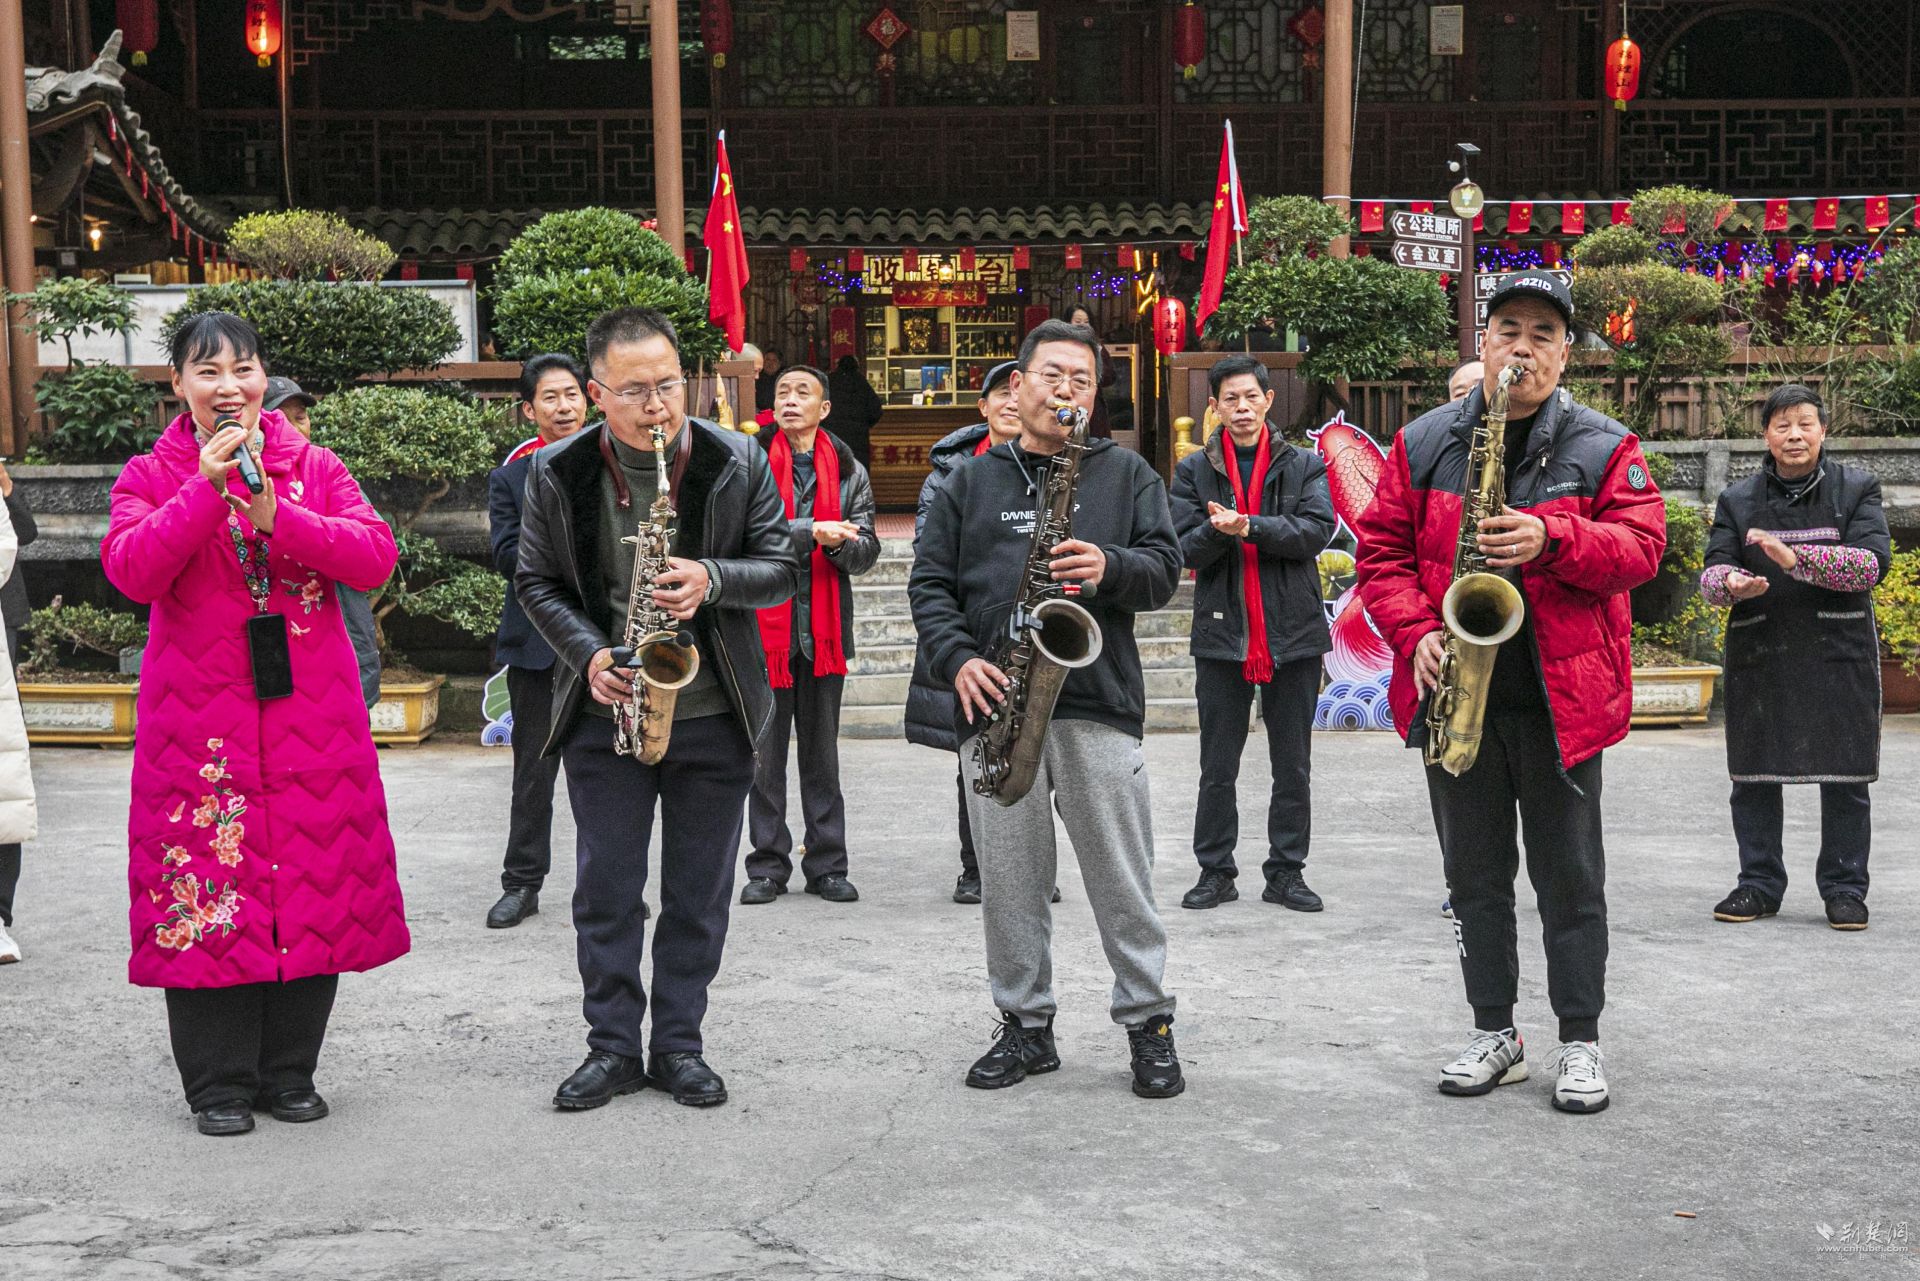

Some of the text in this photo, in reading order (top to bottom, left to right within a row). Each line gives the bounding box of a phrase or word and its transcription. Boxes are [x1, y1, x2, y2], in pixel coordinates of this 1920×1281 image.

[1409, 215, 1459, 236] 公共厕所
[1412, 246, 1455, 264] 会议室
